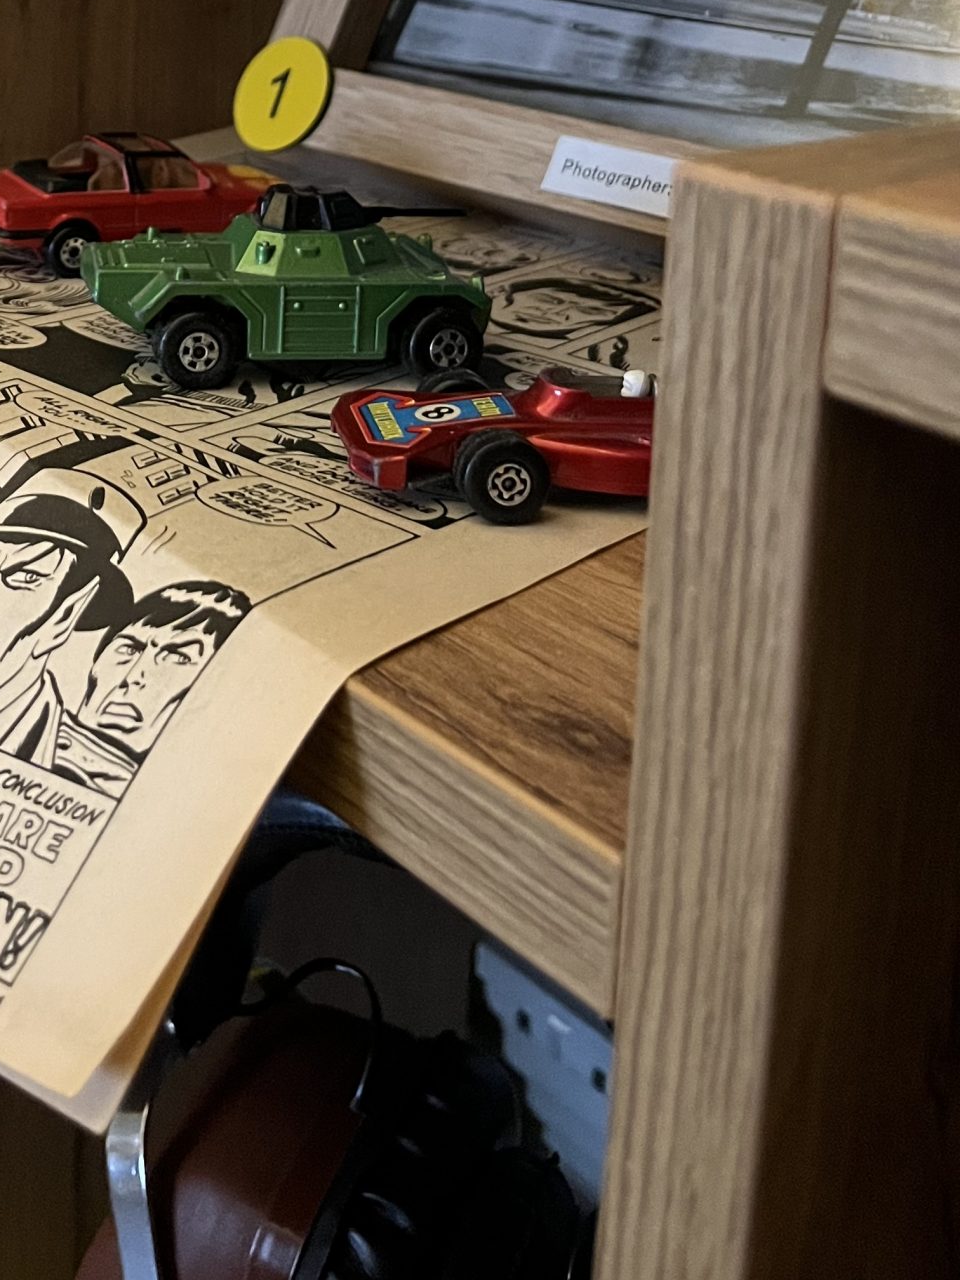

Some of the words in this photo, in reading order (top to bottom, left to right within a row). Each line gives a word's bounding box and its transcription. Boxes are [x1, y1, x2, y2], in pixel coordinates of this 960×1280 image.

[269, 66, 291, 119] 1
[33, 396, 69, 409] ALL
[38, 405, 86, 425] YOU...
[268, 461, 339, 485] BEFORE
[276, 457, 320, 469] AND
[220, 491, 293, 514] RIGHT
[238, 486, 287, 504] HOLD
[285, 504, 310, 512] IT
[253, 483, 323, 508] BETTER
